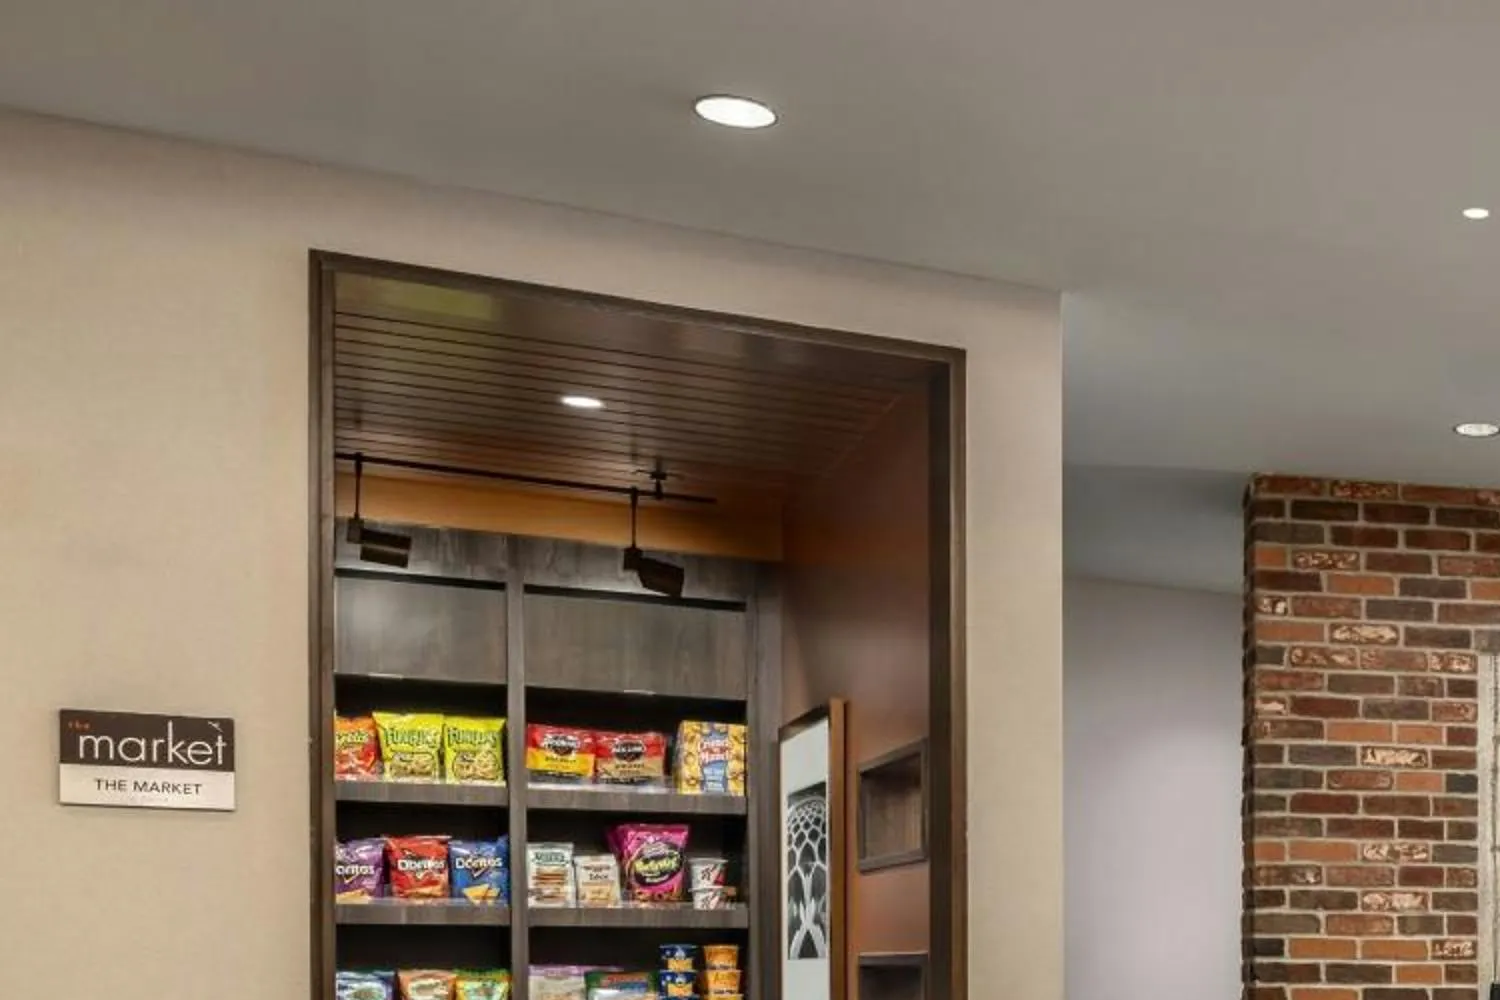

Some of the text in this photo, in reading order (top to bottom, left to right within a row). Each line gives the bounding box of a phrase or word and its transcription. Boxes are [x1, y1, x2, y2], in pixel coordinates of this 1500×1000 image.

[79, 720, 227, 765] market
[94, 777, 203, 796] THE MARKET
[335, 864, 375, 876] oritos
